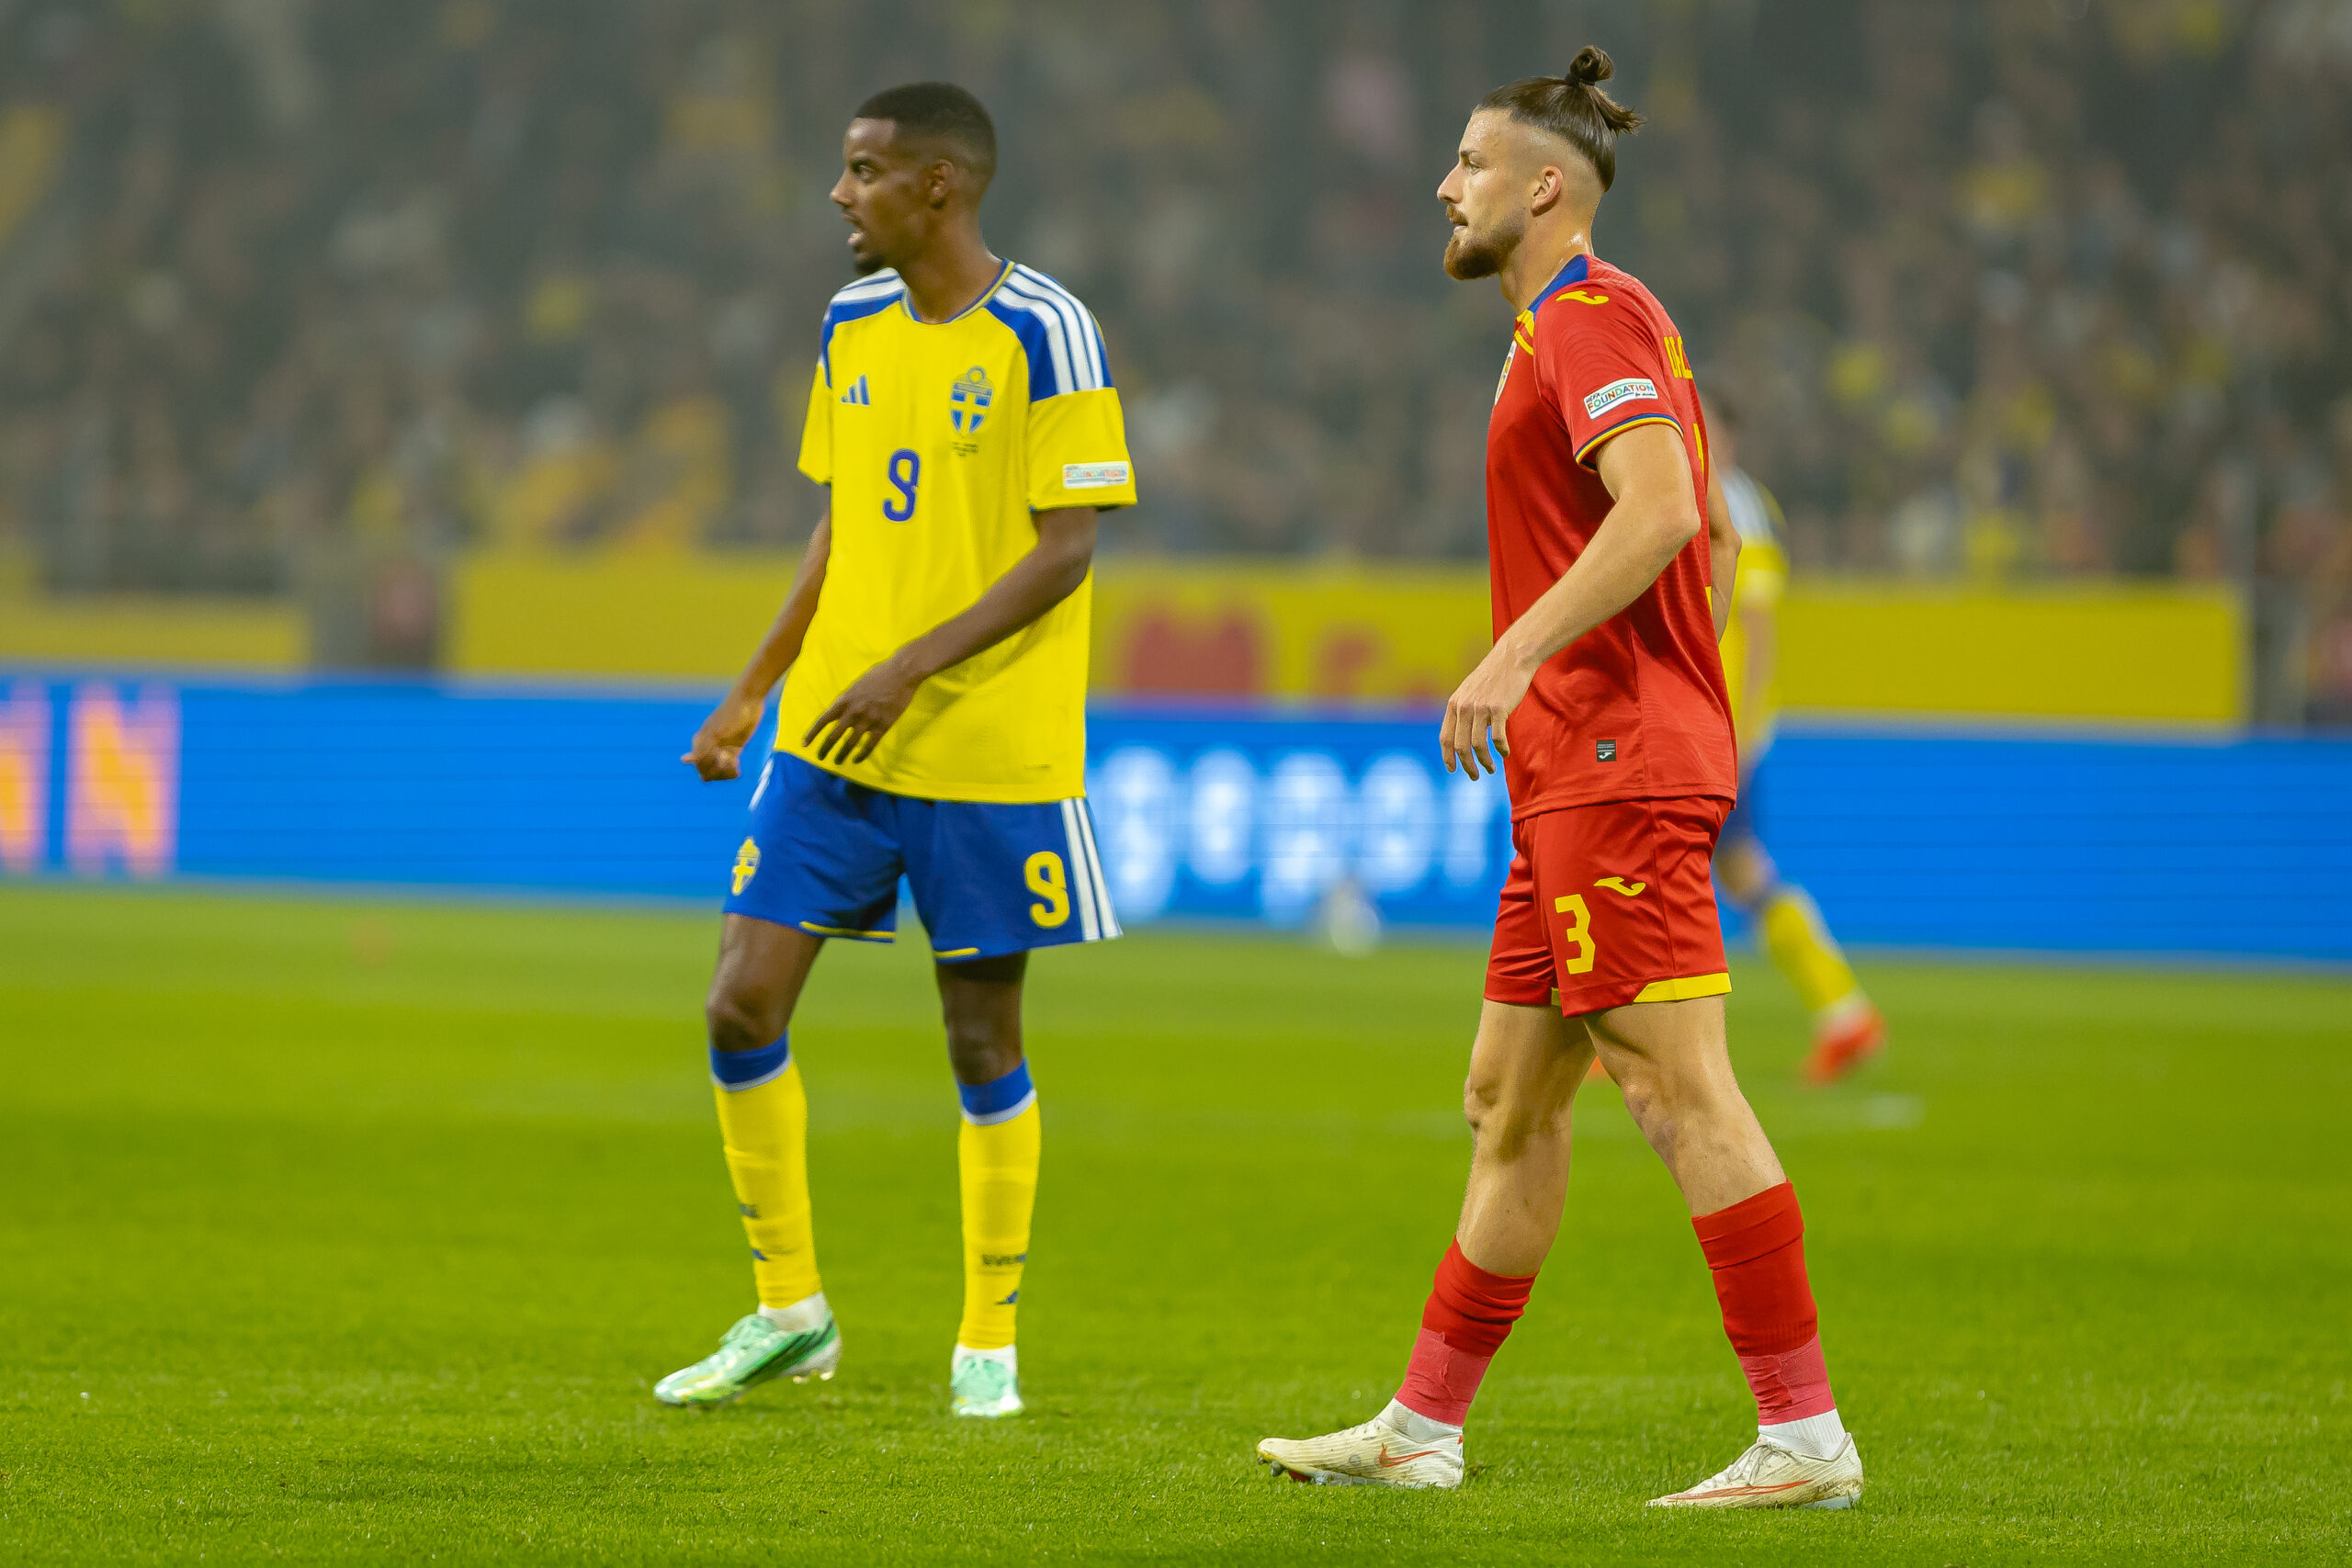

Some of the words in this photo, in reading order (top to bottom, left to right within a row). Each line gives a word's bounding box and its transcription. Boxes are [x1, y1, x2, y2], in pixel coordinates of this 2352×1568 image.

[1587, 384, 1654, 412] FOUNDATION
[883, 448, 921, 522] 9
[1023, 851, 1069, 929] 9
[1555, 894, 1596, 975] 3
